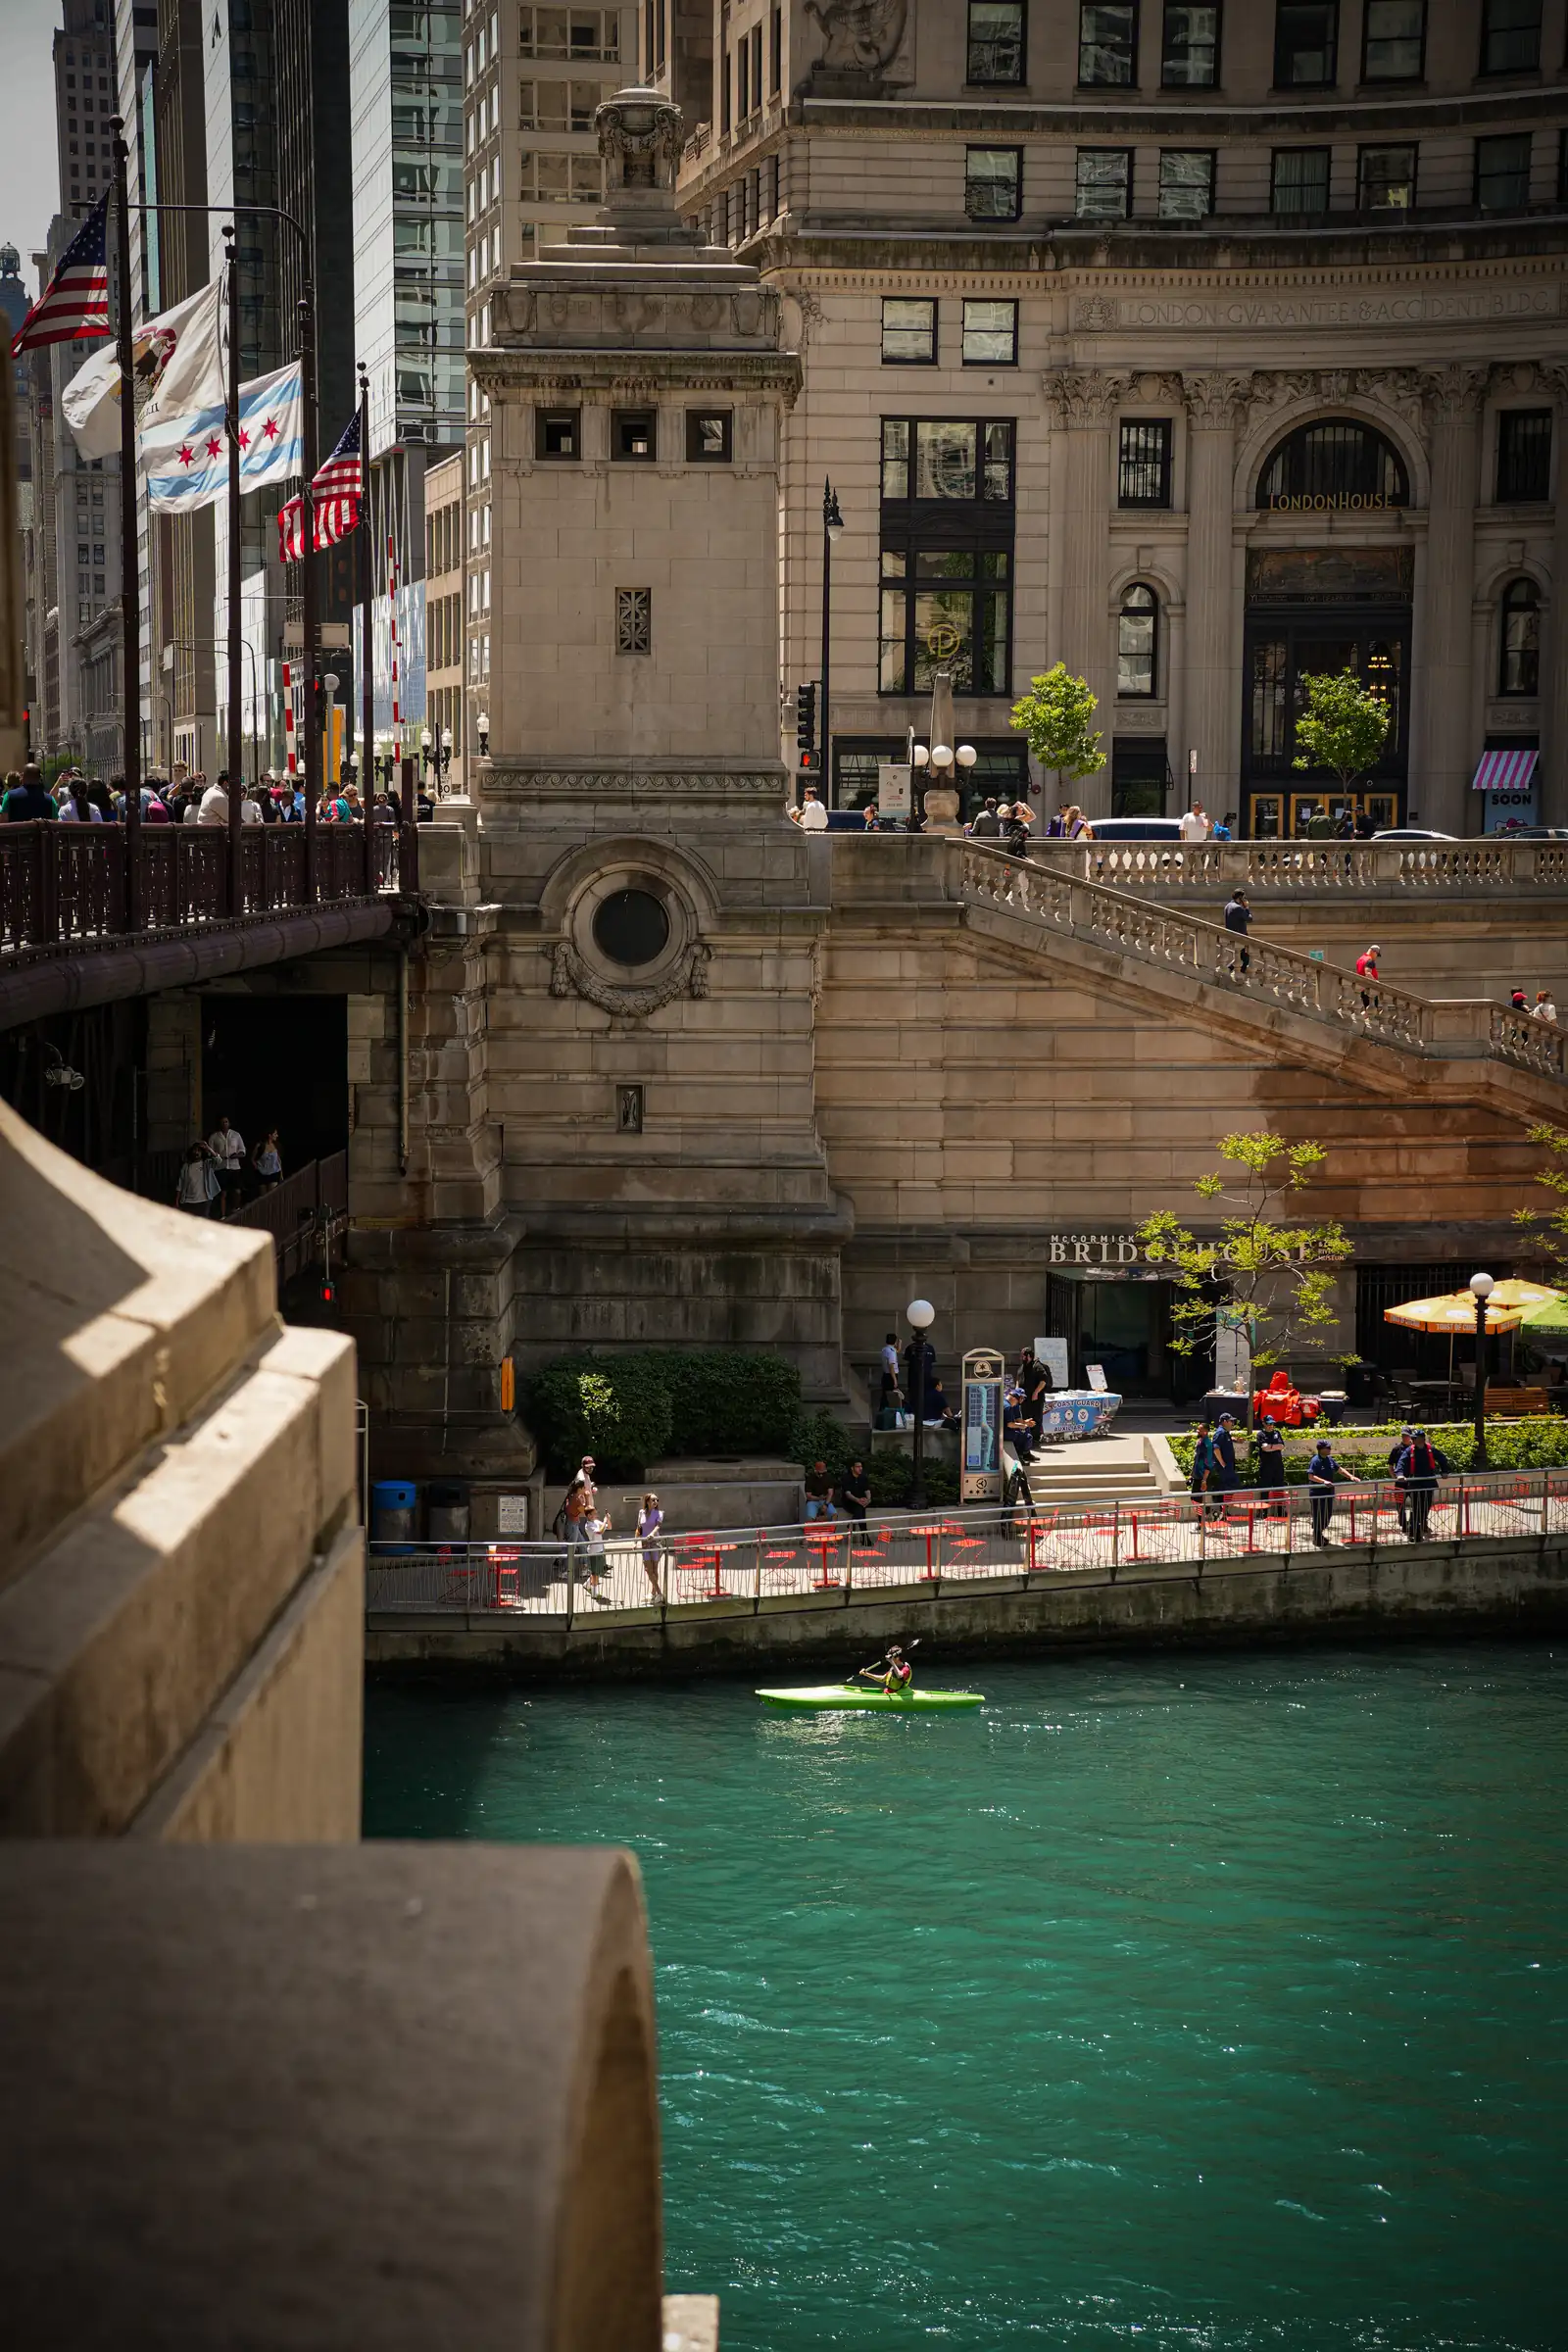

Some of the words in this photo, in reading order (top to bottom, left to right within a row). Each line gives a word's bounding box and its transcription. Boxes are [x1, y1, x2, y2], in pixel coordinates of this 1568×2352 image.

[1128, 303, 1217, 323] LONDON
[1227, 302, 1349, 323] GVARANTEE
[1376, 296, 1485, 320] ACCIDENT
[1491, 291, 1551, 314] BLDG.
[1270, 491, 1393, 510] LONDONHOUSE
[1492, 794, 1531, 805] SOON
[1050, 1242, 1311, 1263] BRIDGHOSE
[1054, 1400, 1075, 1409] COAST
